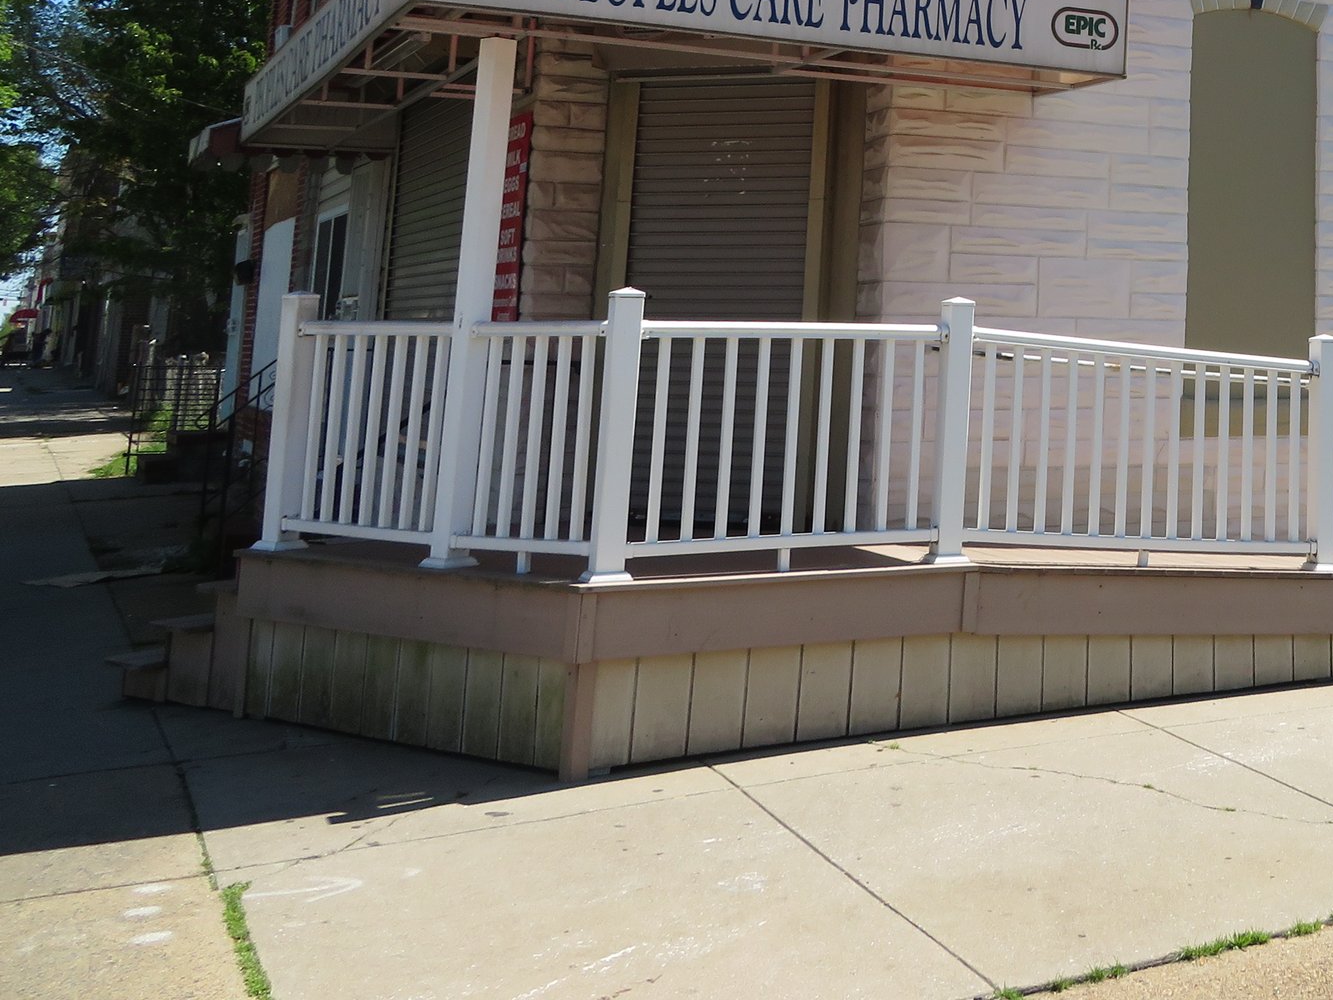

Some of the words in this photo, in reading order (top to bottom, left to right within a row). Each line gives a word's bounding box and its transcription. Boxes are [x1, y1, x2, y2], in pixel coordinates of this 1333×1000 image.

[1064, 14, 1107, 38] EPIC
[501, 201, 521, 219] EREAL
[500, 228, 516, 245] SOFT
